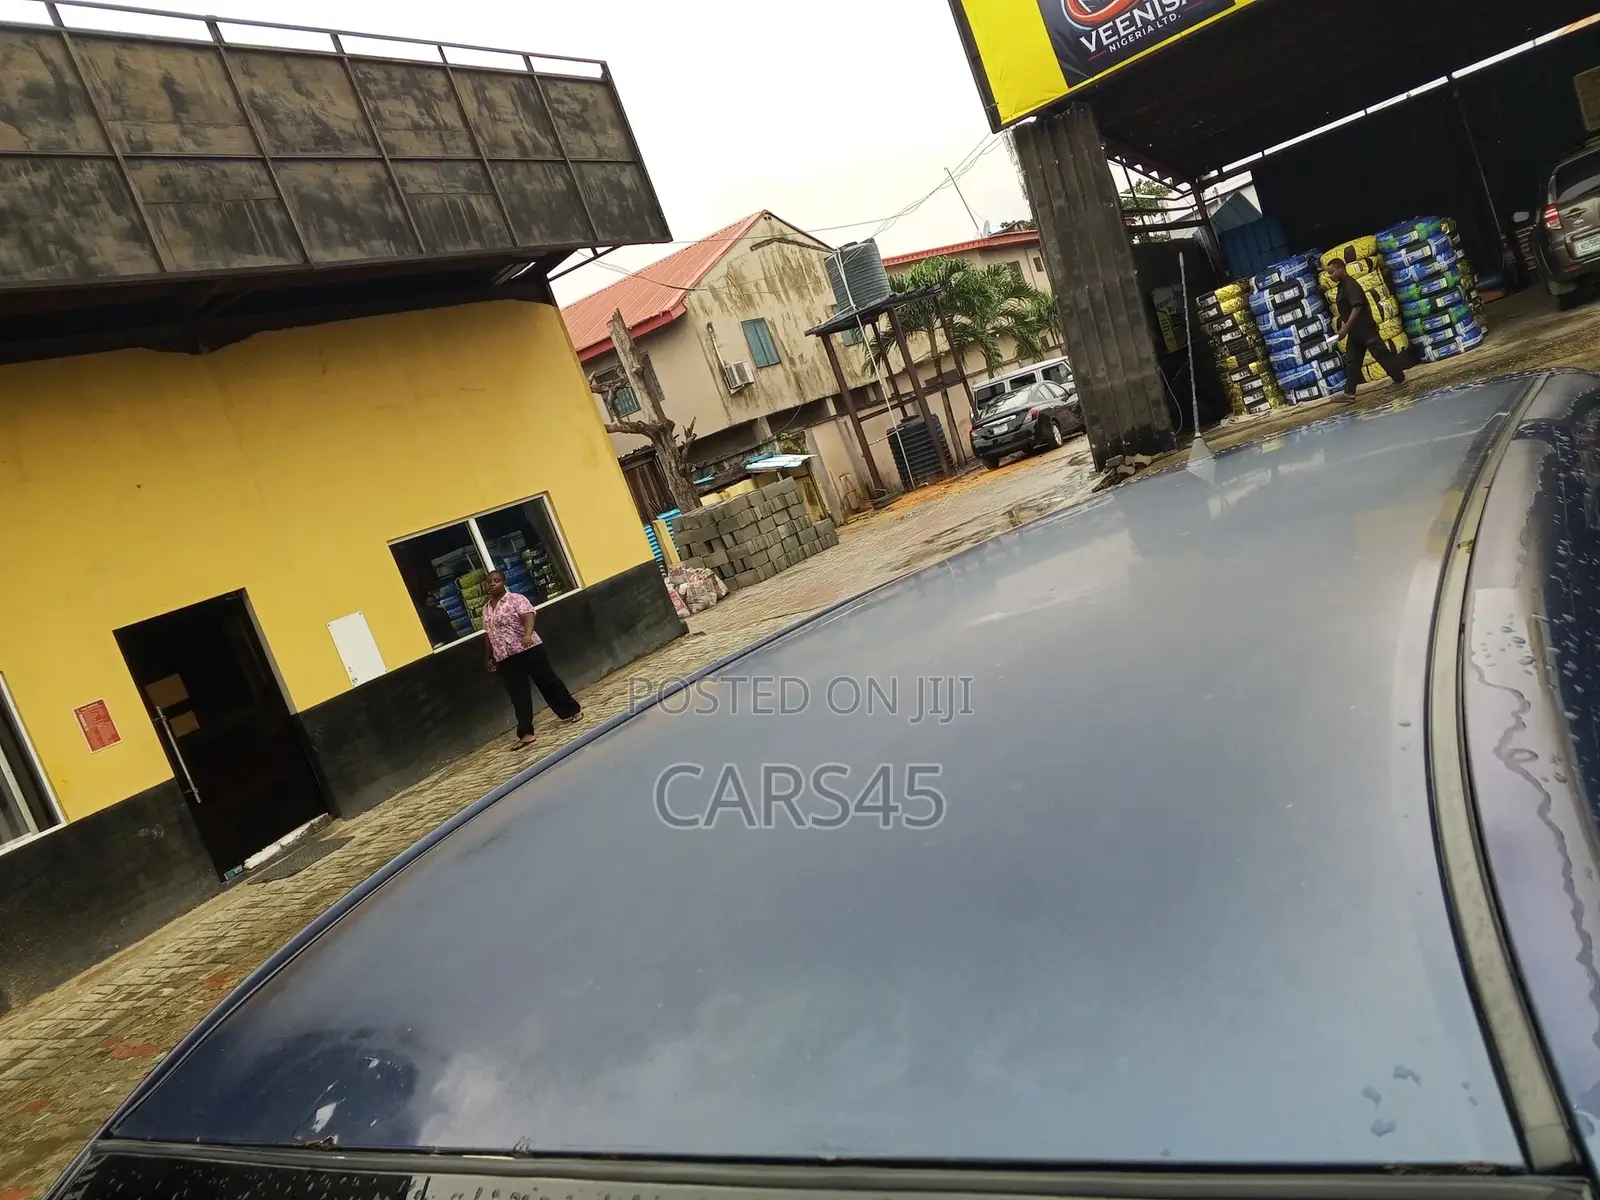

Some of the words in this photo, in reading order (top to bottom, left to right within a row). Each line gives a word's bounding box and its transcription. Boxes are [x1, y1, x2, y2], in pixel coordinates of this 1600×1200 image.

[1079, 0, 1187, 53] VEENIS
[1108, 25, 1155, 52] NIGERIA
[1156, 13, 1181, 28] LTD.
